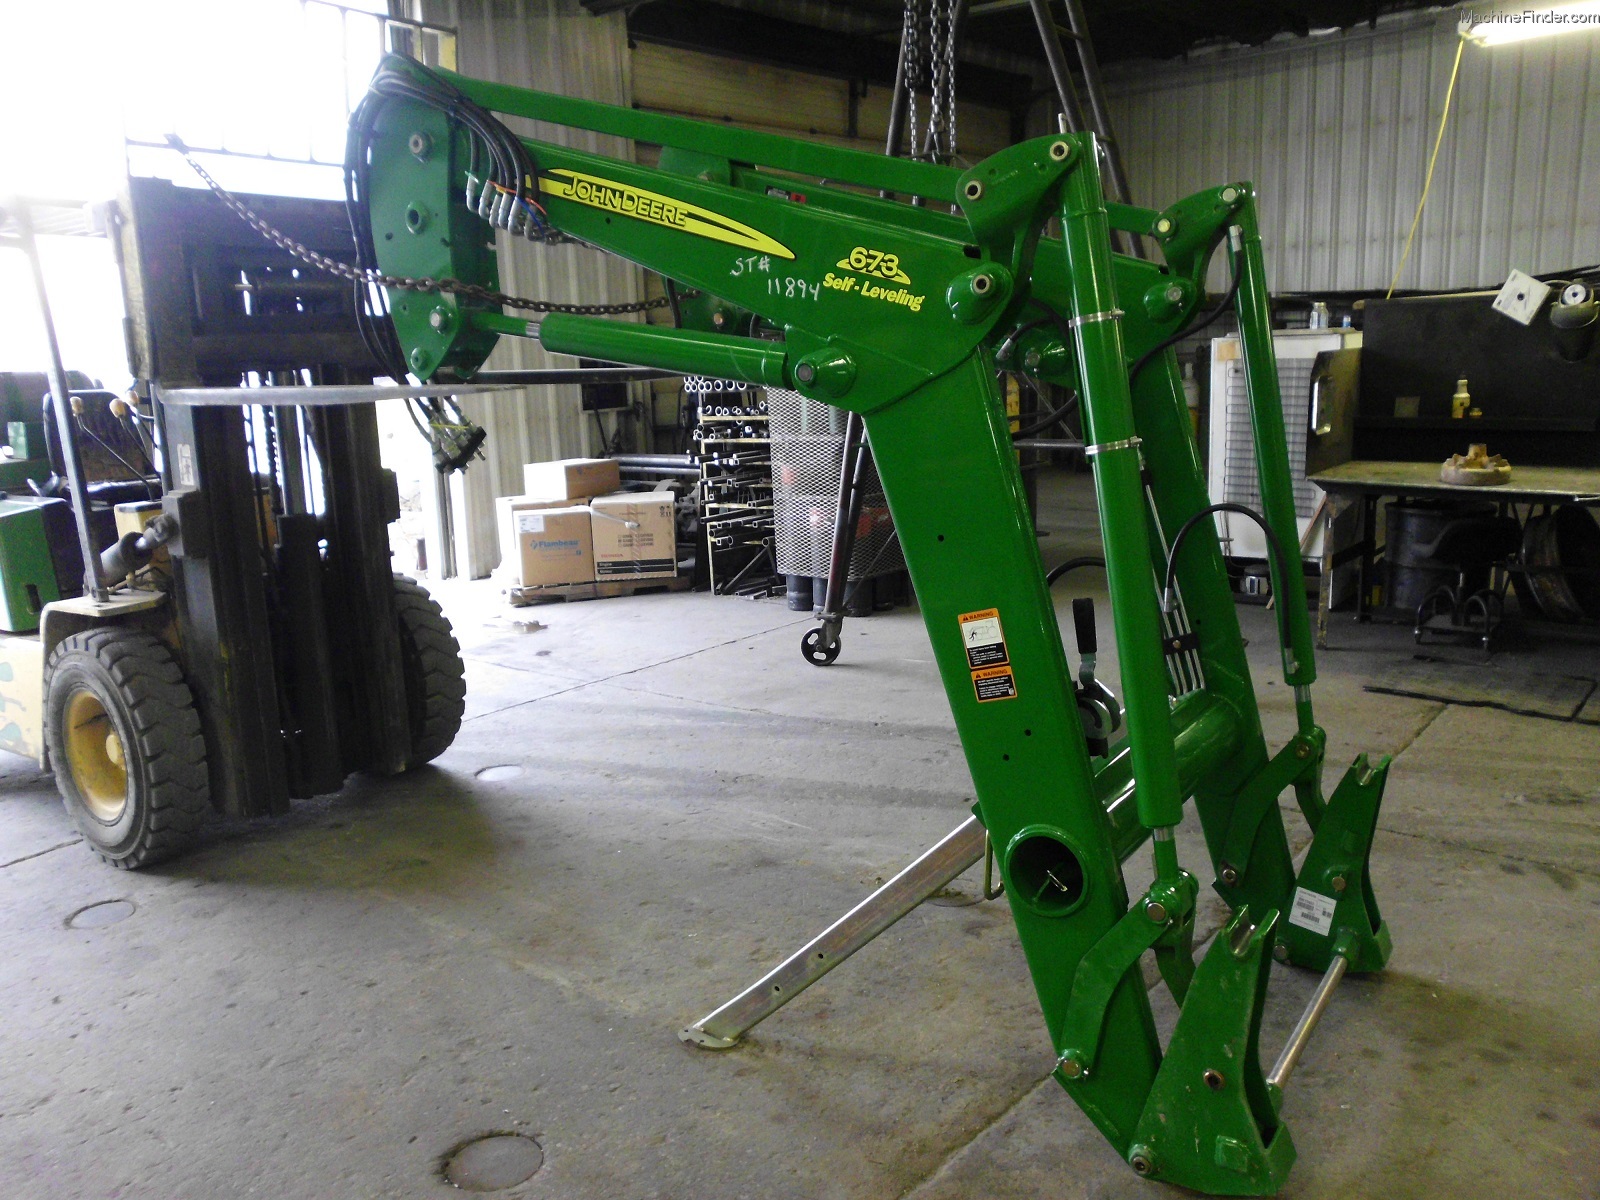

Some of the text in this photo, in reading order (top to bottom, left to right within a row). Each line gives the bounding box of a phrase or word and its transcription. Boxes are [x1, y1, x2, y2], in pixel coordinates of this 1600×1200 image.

[563, 176, 688, 228] JOHN DEERE
[729, 255, 771, 276] ST#
[849, 246, 899, 278] 673
[767, 277, 820, 301] 11894
[538, 540, 579, 548] Flambeau
[969, 611, 993, 620] WARNING
[983, 669, 1007, 677] WARNING
